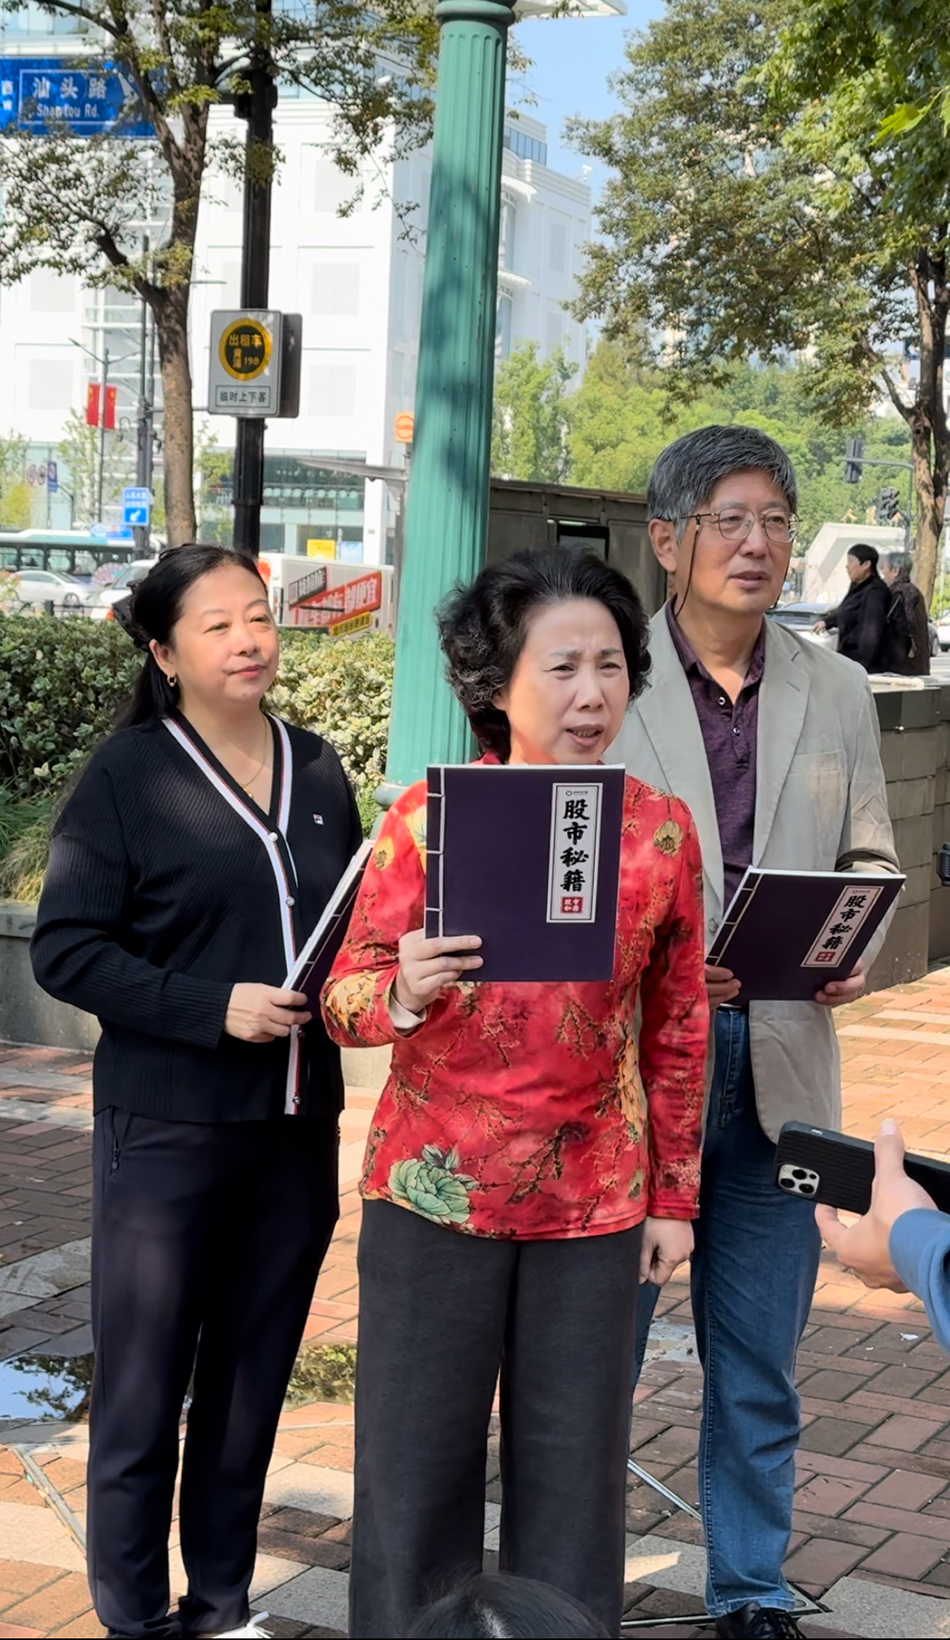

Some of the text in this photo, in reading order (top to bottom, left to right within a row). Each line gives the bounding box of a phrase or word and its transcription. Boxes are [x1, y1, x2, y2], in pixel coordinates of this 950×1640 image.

[32, 76, 106, 99] 汕头路
[84, 103, 99, 117] Rd.
[229, 334, 262, 348] 出租车
[244, 356, 259, 365] 198
[220, 391, 266, 402] 临时上下客
[560, 799, 590, 892] 股市秘籍
[822, 895, 867, 950] 股市秘籍
